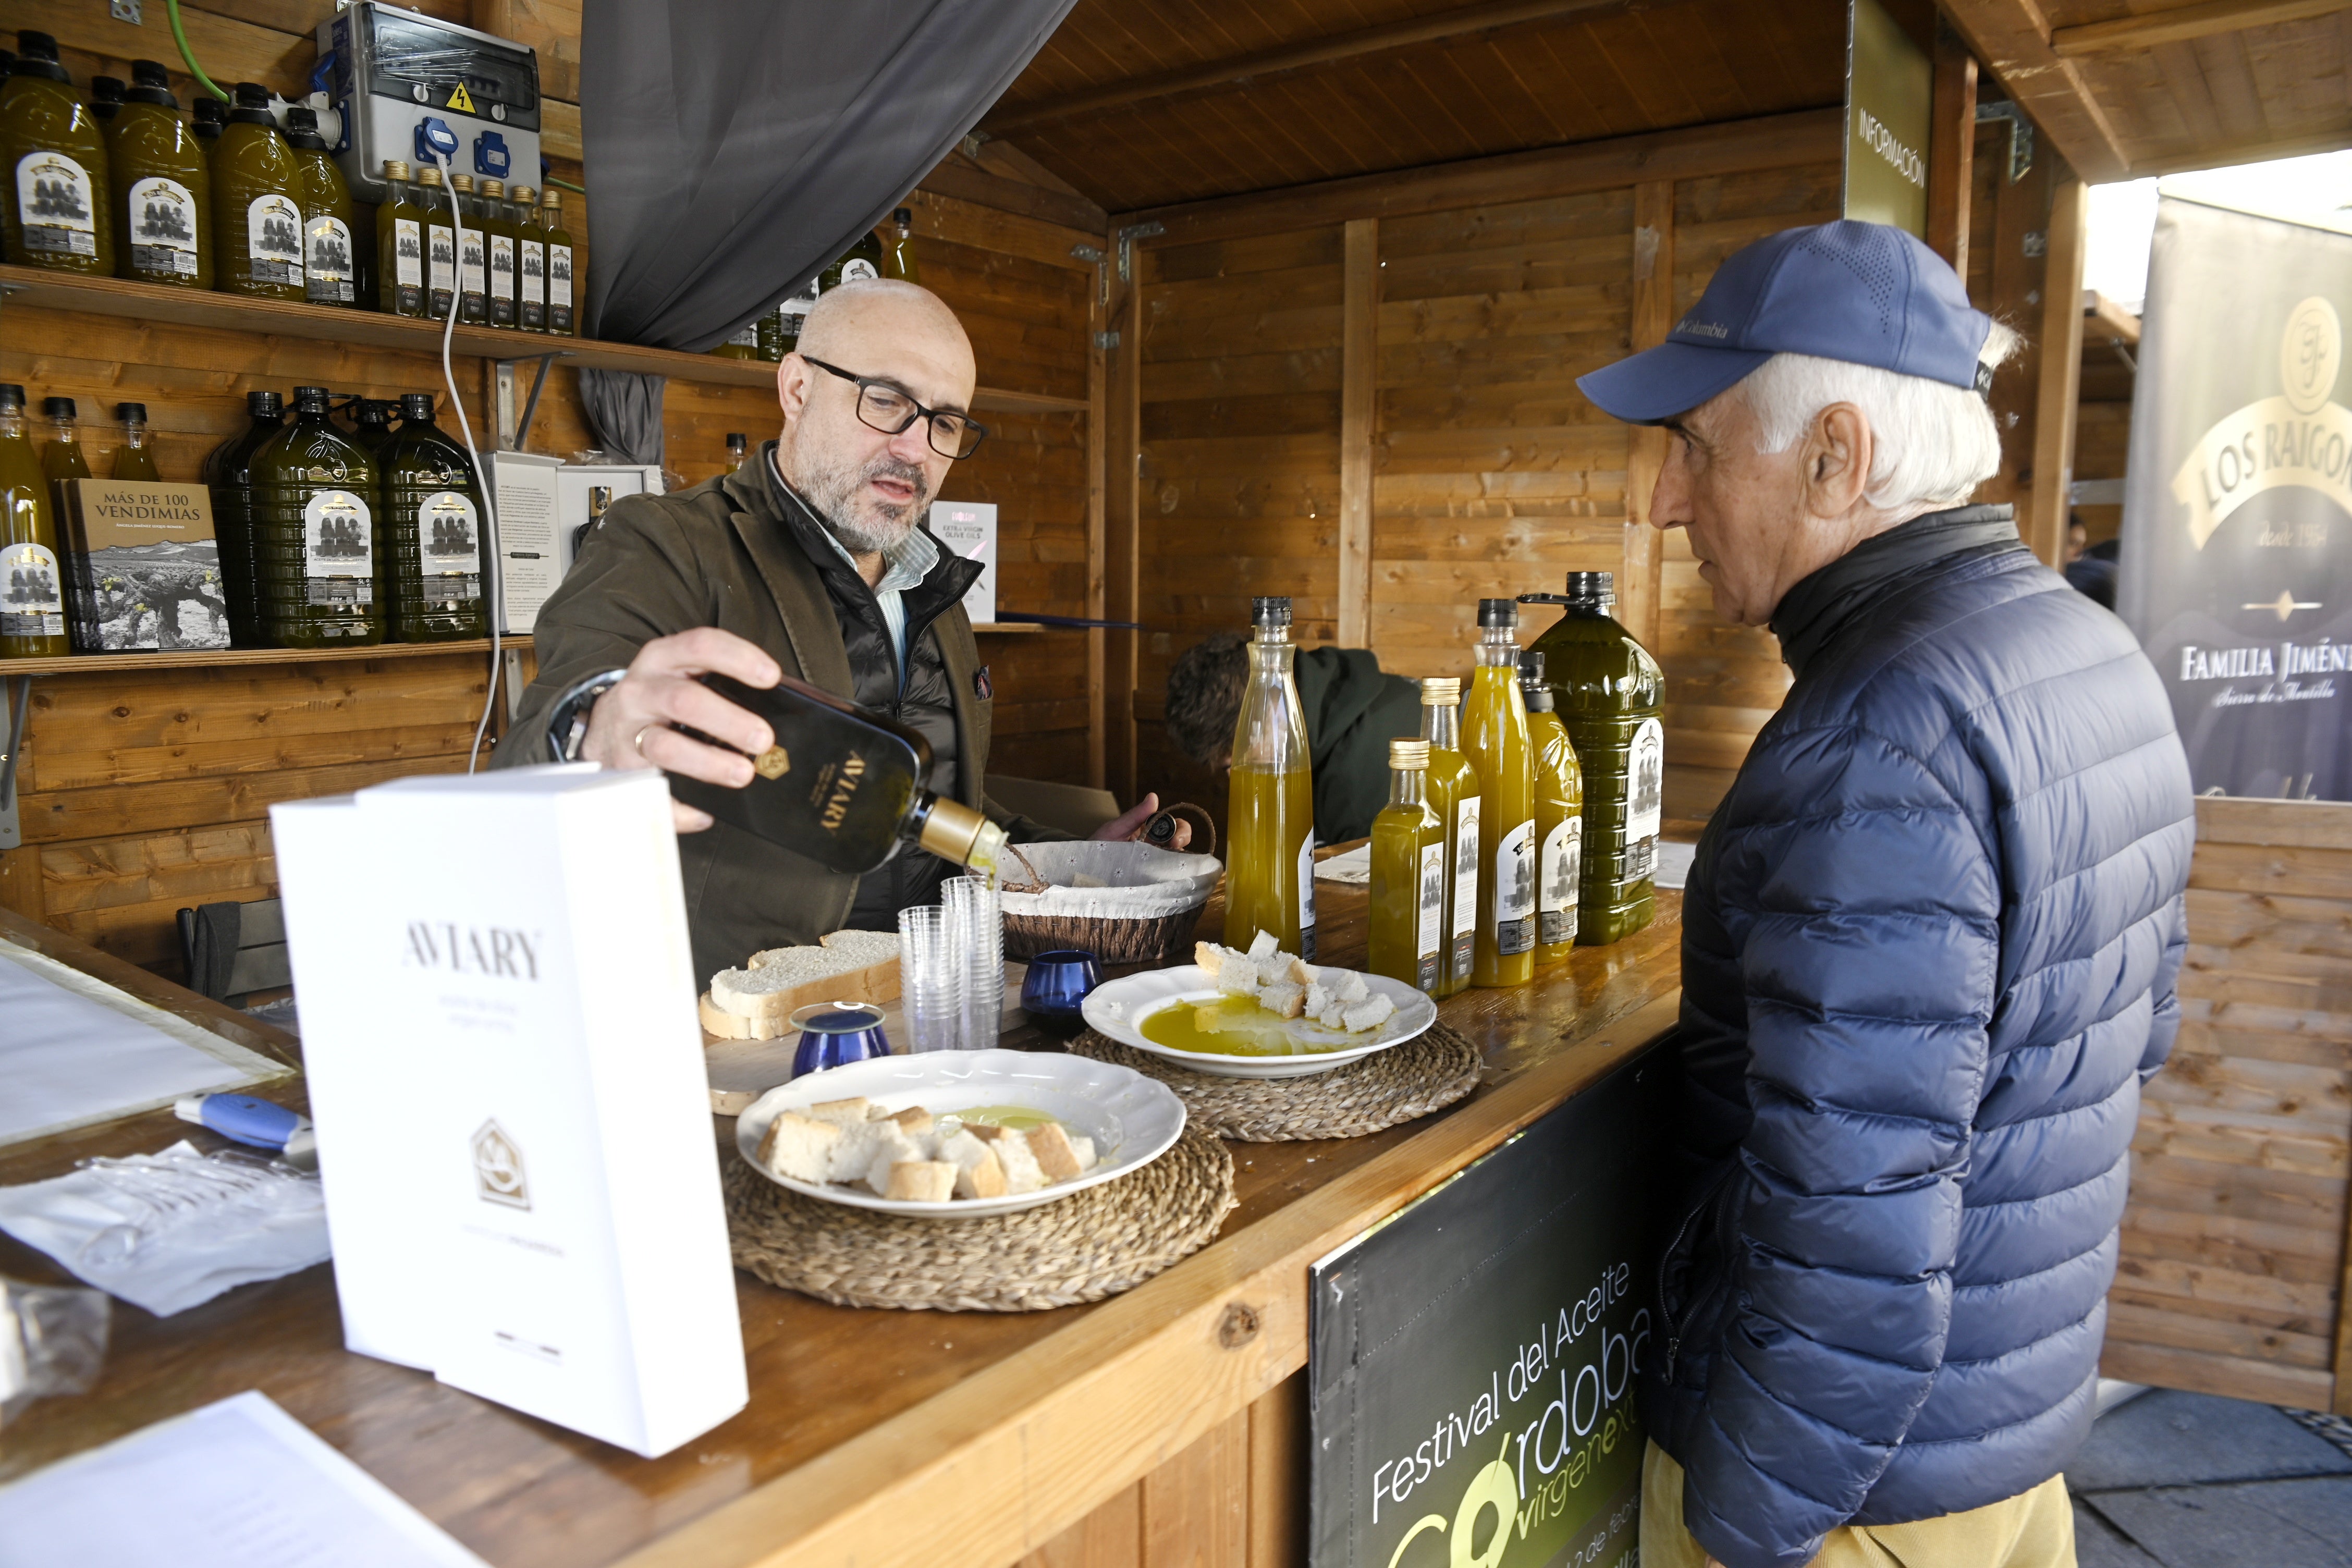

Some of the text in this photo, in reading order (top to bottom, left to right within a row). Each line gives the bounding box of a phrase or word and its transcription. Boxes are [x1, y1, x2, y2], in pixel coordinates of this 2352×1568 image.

[1859, 107, 1926, 189] INFORMACIÓN
[1683, 318, 1728, 339] Columbia
[104, 491, 189, 506] MÁS DE 100
[2200, 431, 2258, 512] LOS
[95, 505, 200, 520] VENDIMIAS
[819, 750, 866, 837] AVIARY
[401, 919, 543, 983] AVIARY
[1373, 1262, 1630, 1524] Festival del Aceite
[1586, 1532, 1606, 1563] de
